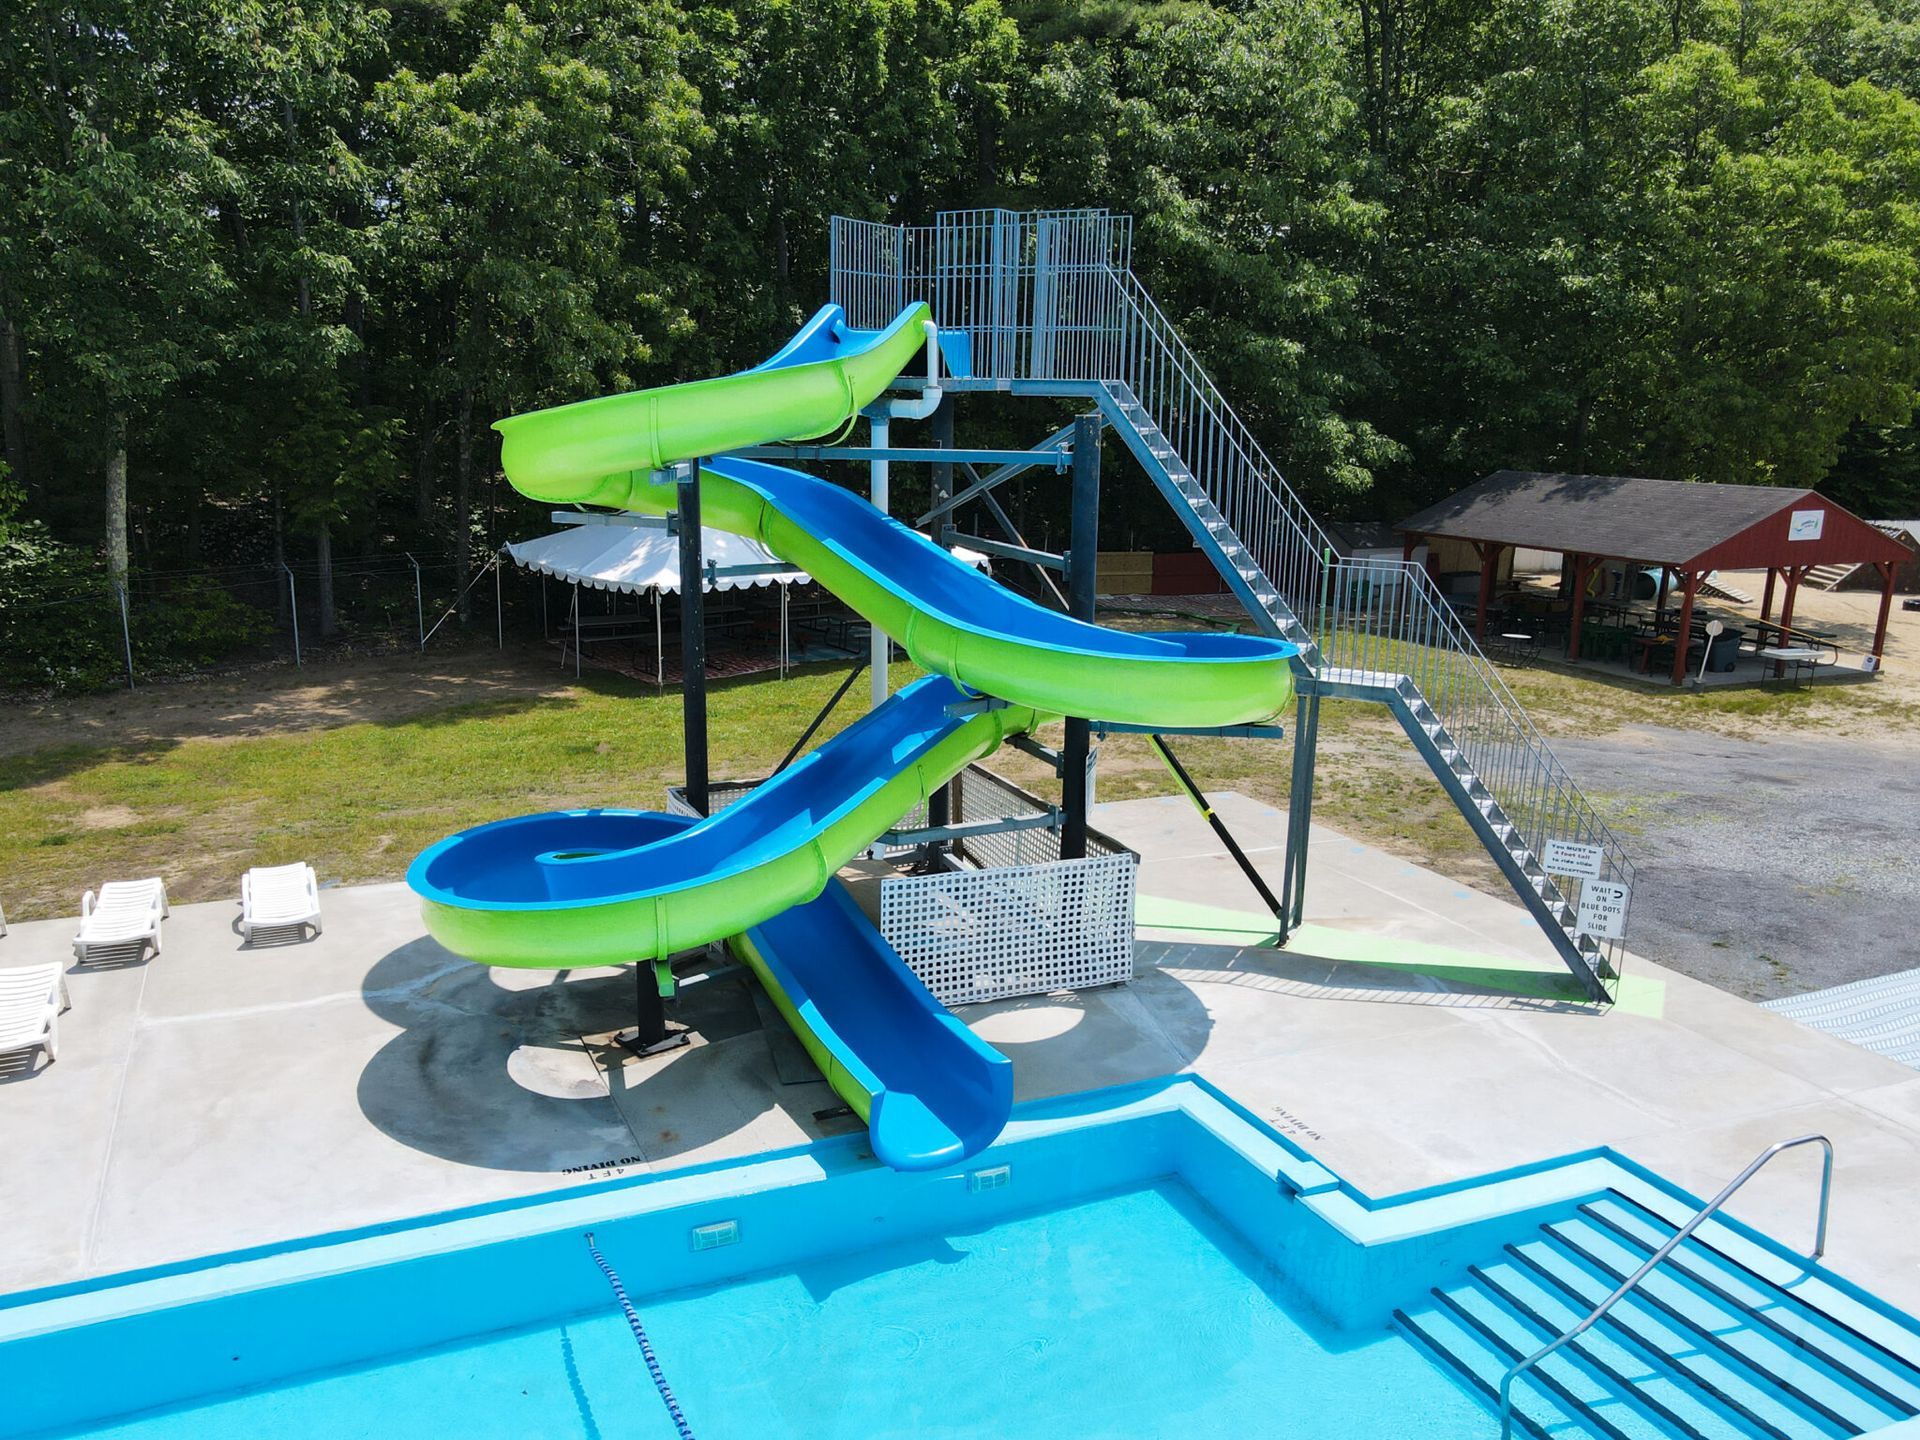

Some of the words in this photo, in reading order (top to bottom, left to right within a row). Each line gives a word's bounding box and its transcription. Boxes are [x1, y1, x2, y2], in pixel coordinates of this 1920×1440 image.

[1591, 885, 1611, 894] WAIT
[1581, 902, 1600, 910] BLUE
[1602, 906, 1621, 914] DOTS
[1593, 913, 1608, 921] FOR
[1587, 922, 1607, 931] SLIDE
[620, 1155, 642, 1164] NO
[561, 1160, 616, 1175] DIVING
